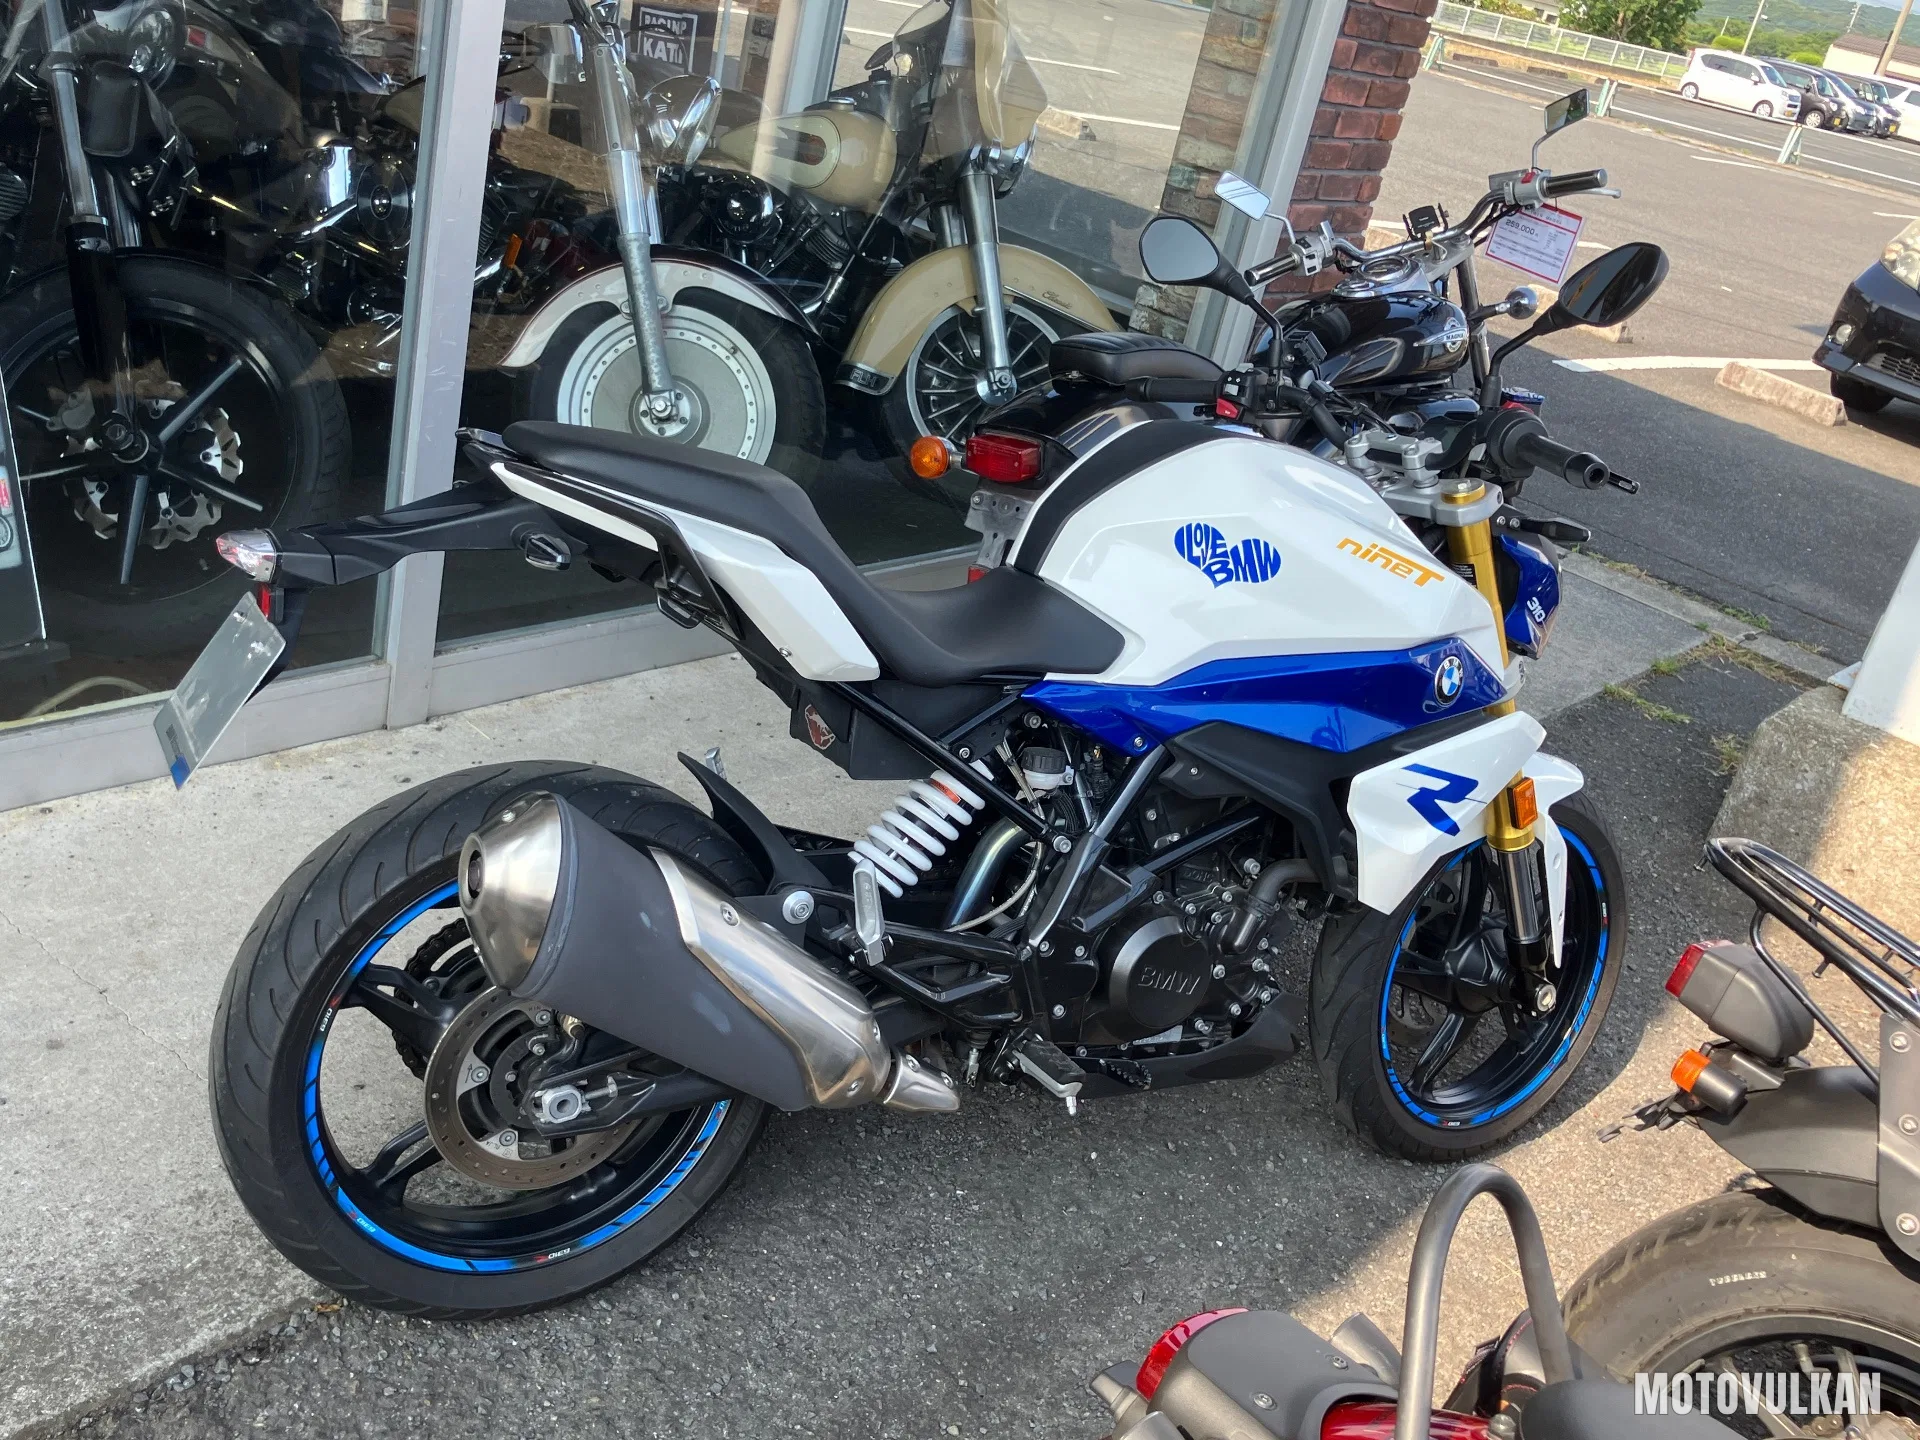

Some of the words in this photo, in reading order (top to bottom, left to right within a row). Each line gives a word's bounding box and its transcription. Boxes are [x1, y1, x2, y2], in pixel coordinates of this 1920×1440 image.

[1185, 522, 1230, 570] LOVE
[1201, 538, 1282, 589] BMW
[1336, 537, 1445, 587] nineT
[1526, 596, 1546, 623] 310
[1137, 965, 1201, 995] BMW
